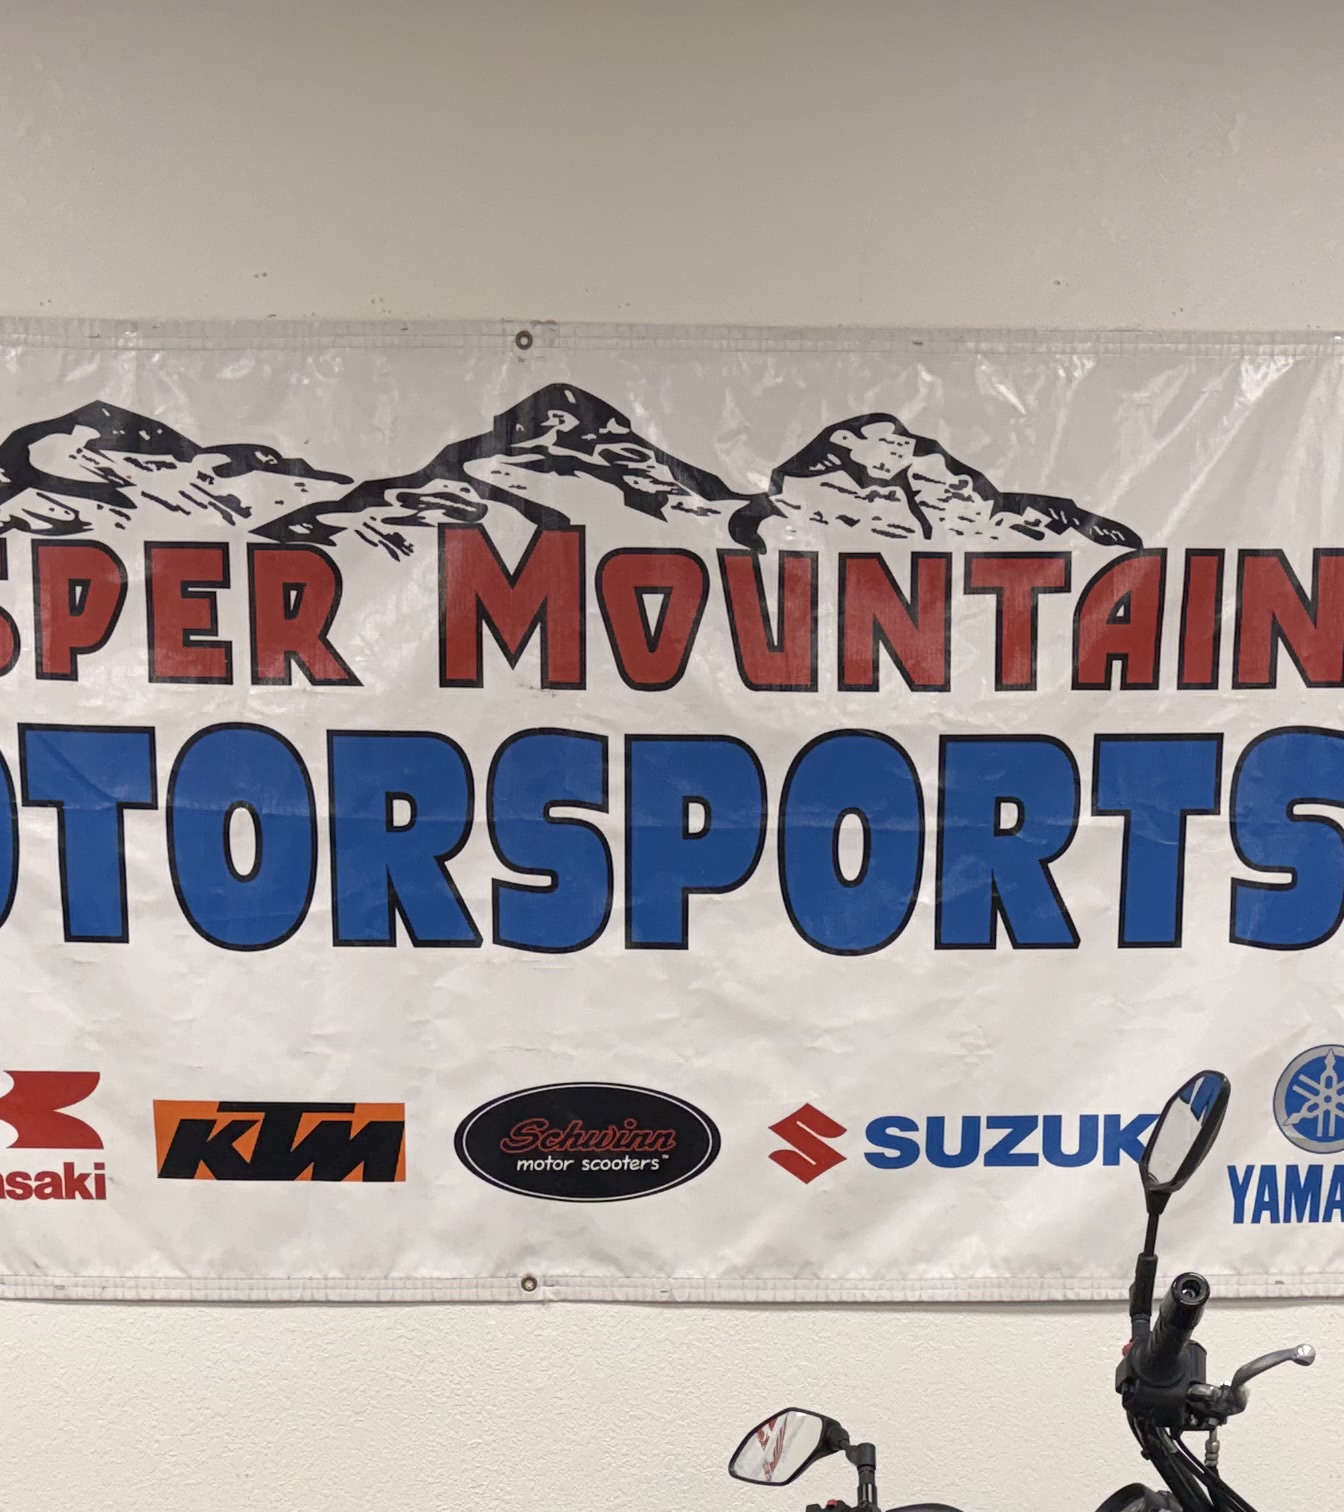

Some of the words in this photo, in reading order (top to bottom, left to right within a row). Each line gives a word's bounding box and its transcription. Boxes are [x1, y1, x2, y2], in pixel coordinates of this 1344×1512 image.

[157, 1101, 405, 1182] KTM
[500, 1118, 676, 1154] Schwinn
[864, 1113, 1161, 1169] SUZUK
[516, 1155, 575, 1171] motor
